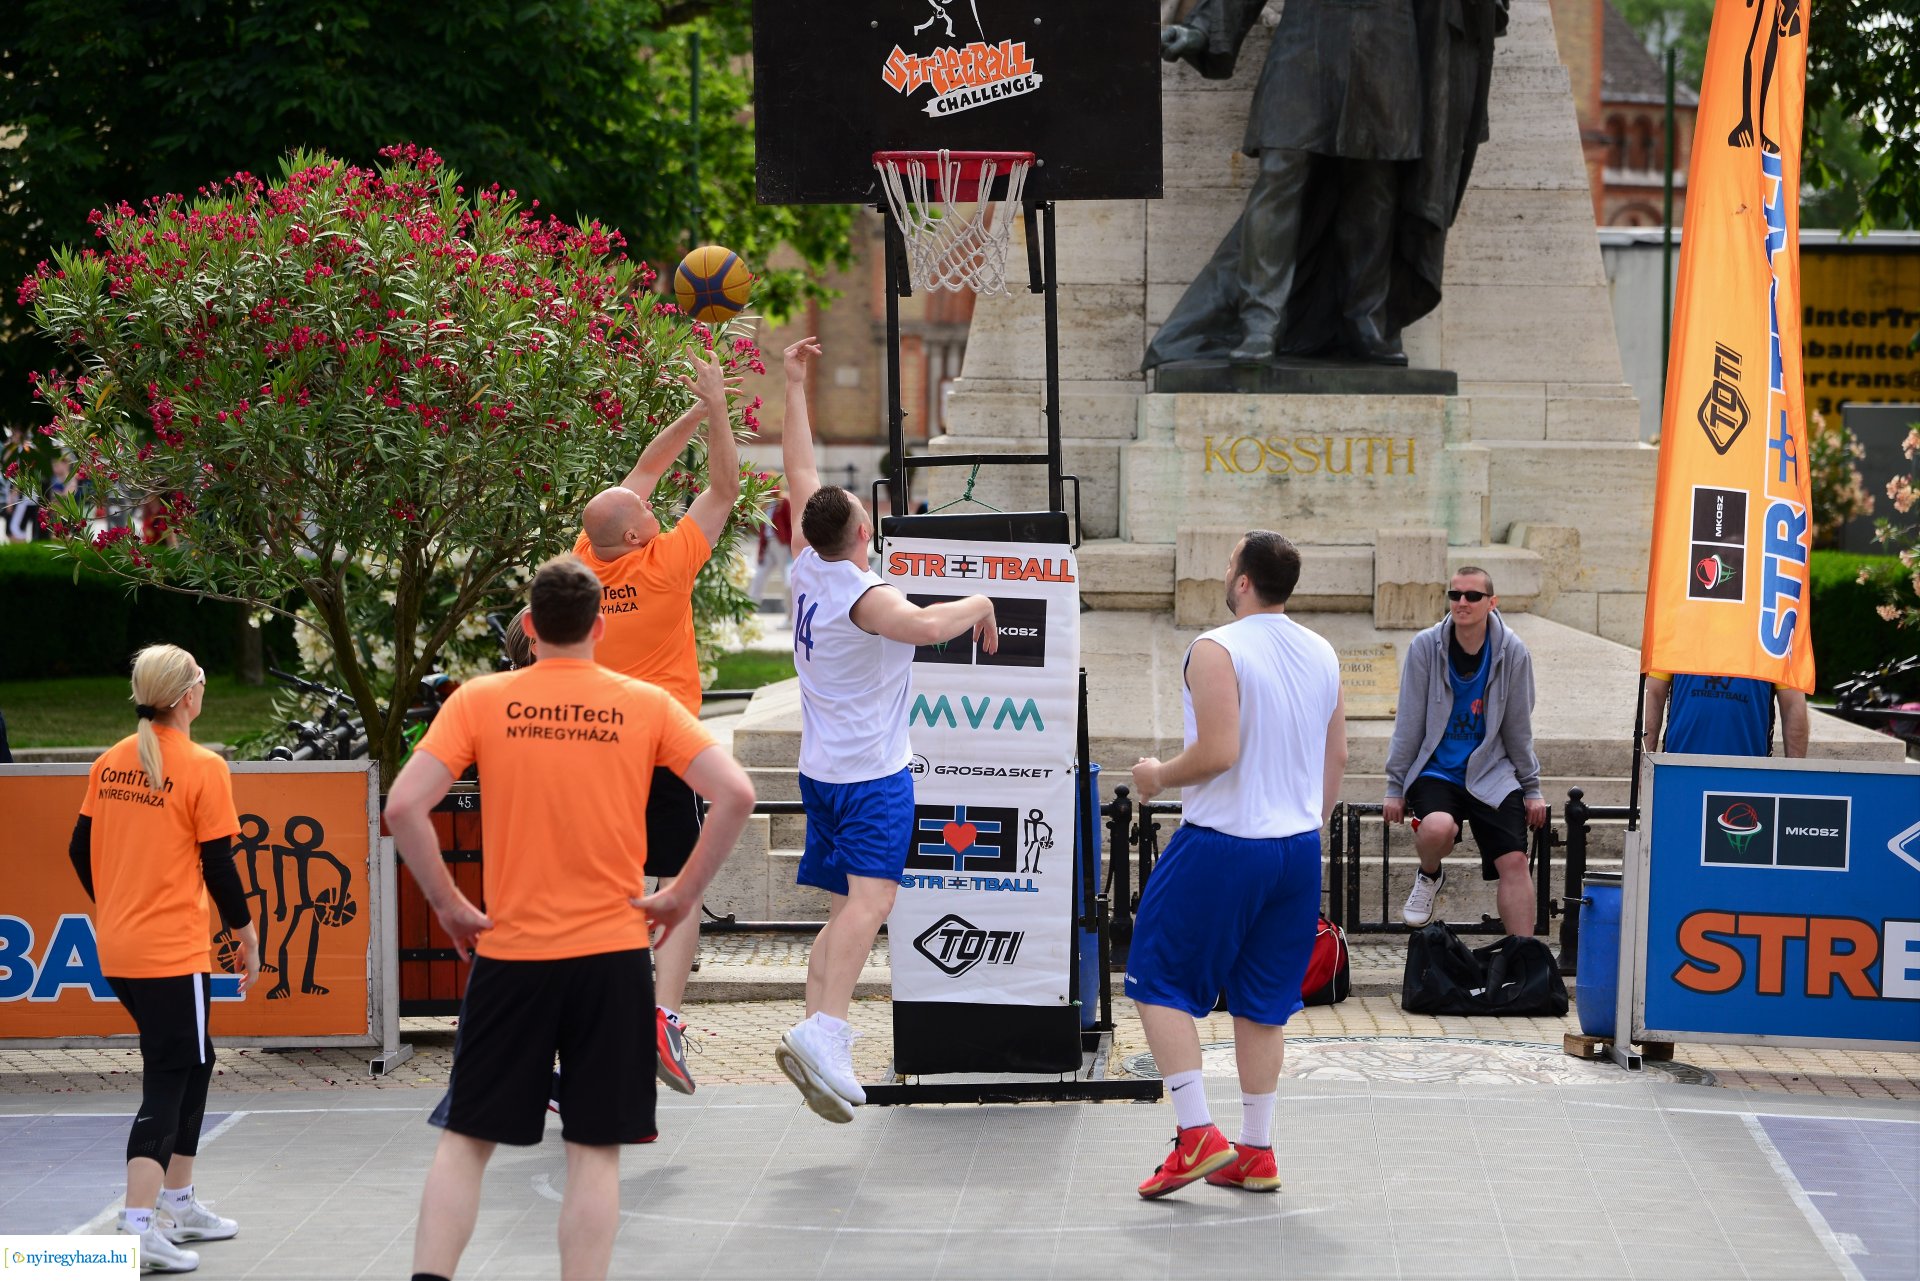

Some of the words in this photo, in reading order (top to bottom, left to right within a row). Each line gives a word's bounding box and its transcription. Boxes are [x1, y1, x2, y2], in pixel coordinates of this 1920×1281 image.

[937, 75, 1035, 113] CHALLENGE
[1709, 340, 1742, 430] TOTI
[1203, 435, 1416, 476] KOSSUTH
[1715, 495, 1724, 538] MKOSZ
[887, 551, 1076, 583] STREETBALL
[794, 592, 819, 662] 14
[996, 626, 1038, 637] KOSZ
[506, 701, 624, 726] ContiTech
[909, 693, 1045, 732] MVM
[506, 723, 620, 744] NYÍREGYHÁZA
[101, 766, 174, 794] ContiTeh
[934, 765, 1054, 779] GROSBASKET
[99, 785, 165, 809] NYÍREGYHÁZA
[1785, 826, 1839, 837] MKOSZ
[900, 874, 1039, 893] STREETBALL
[938, 928, 1026, 966] TOTI
